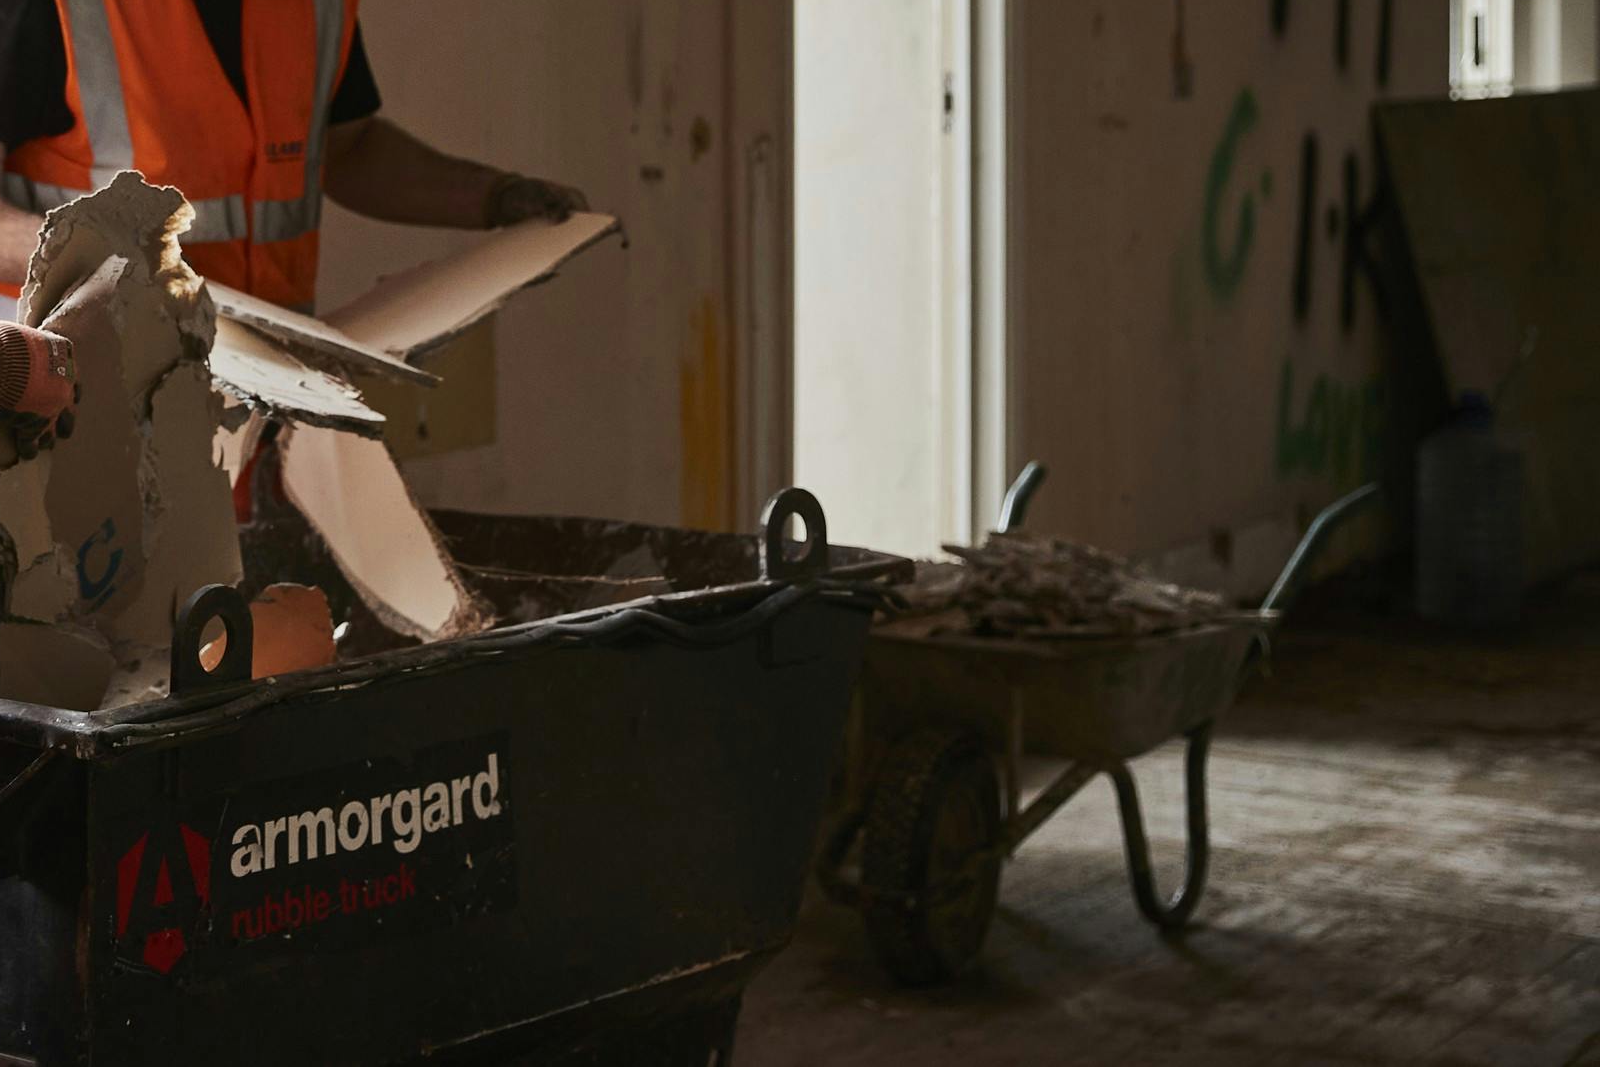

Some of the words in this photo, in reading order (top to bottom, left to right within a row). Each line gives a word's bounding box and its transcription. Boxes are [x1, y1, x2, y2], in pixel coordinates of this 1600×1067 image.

[230, 753, 502, 878] armorgard
[231, 887, 332, 939] rubble
[338, 864, 417, 916] truck
